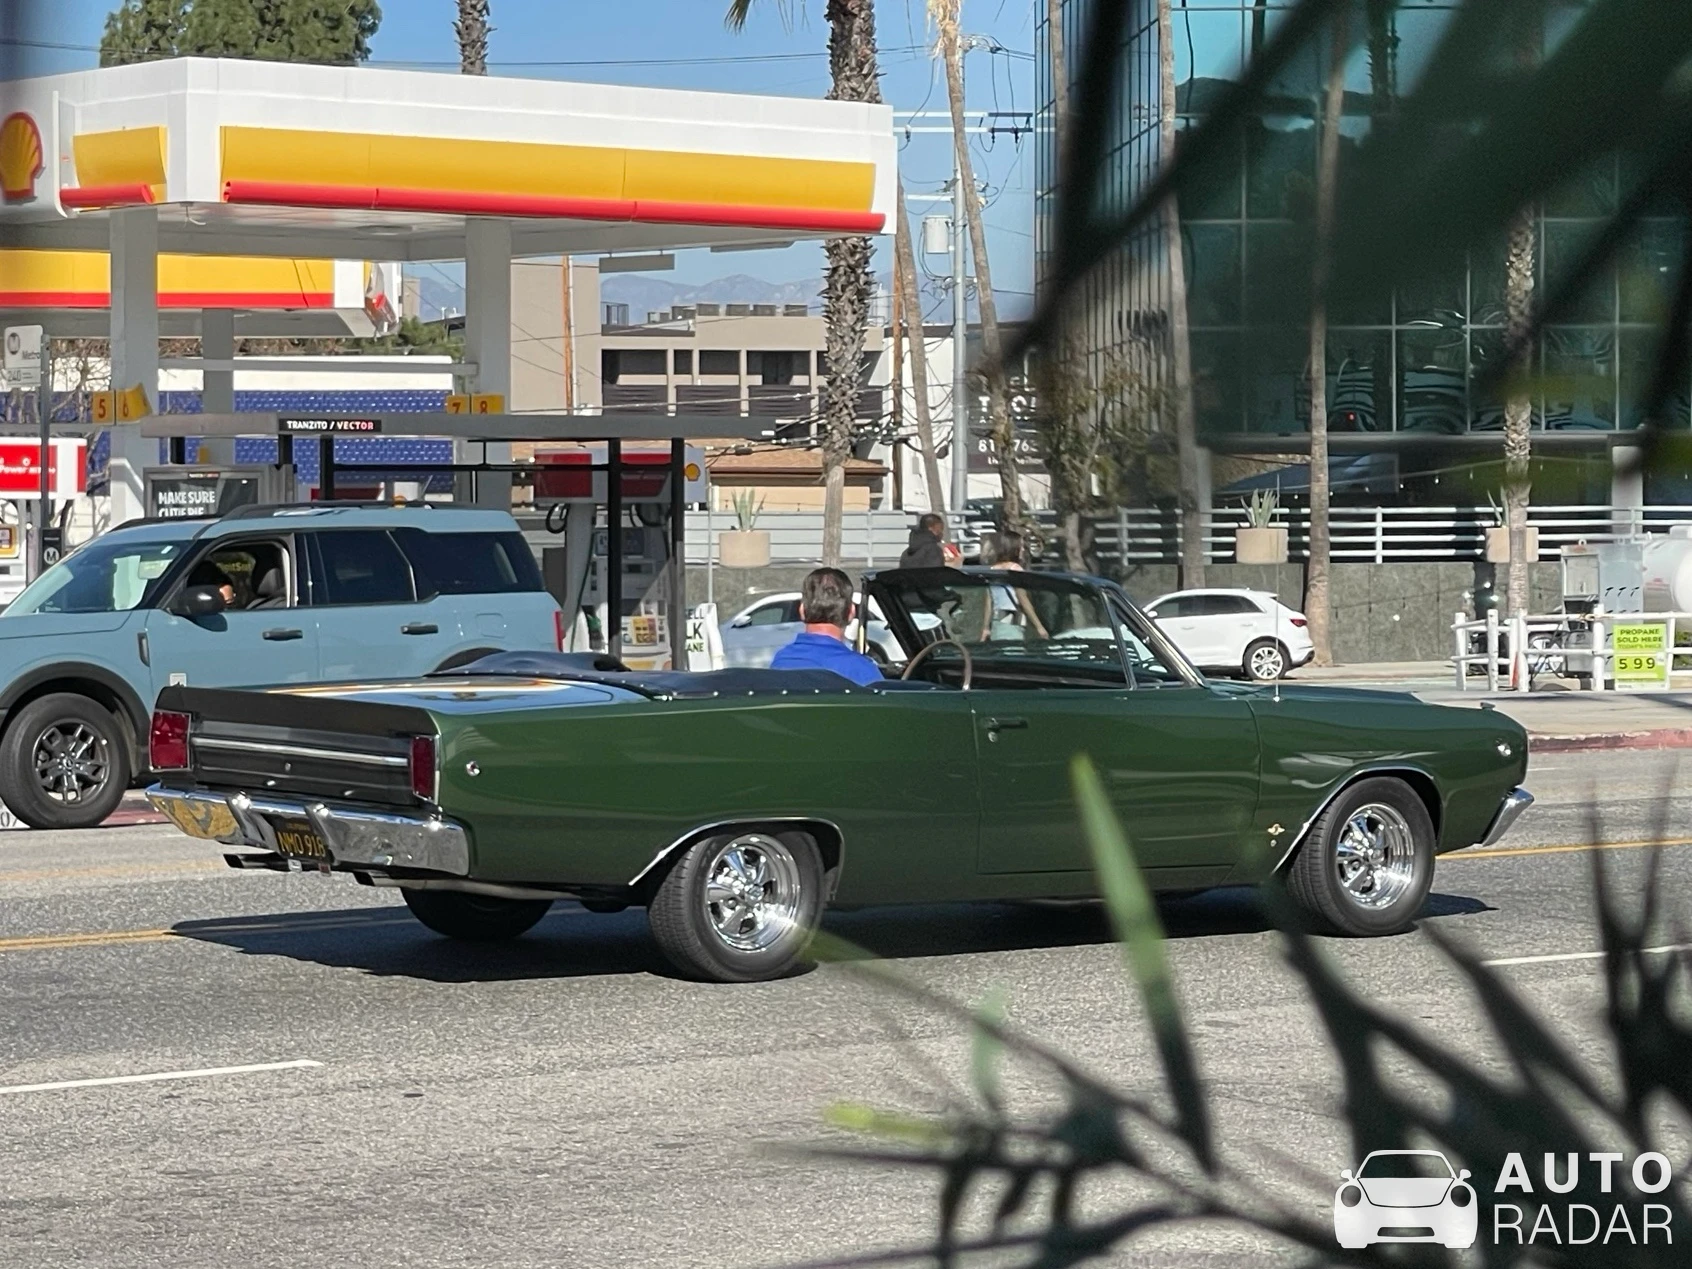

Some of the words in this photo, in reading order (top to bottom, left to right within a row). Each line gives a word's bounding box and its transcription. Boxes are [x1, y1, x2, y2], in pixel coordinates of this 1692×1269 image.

[98, 398, 106, 418] 5
[122, 394, 129, 417] 6
[452, 402, 461, 414] 7
[286, 420, 328, 430] TRANZITO
[329, 420, 336, 430] /
[336, 421, 374, 430] VECTOR
[158, 491, 187, 505] MAKE
[187, 490, 216, 504] SURE
